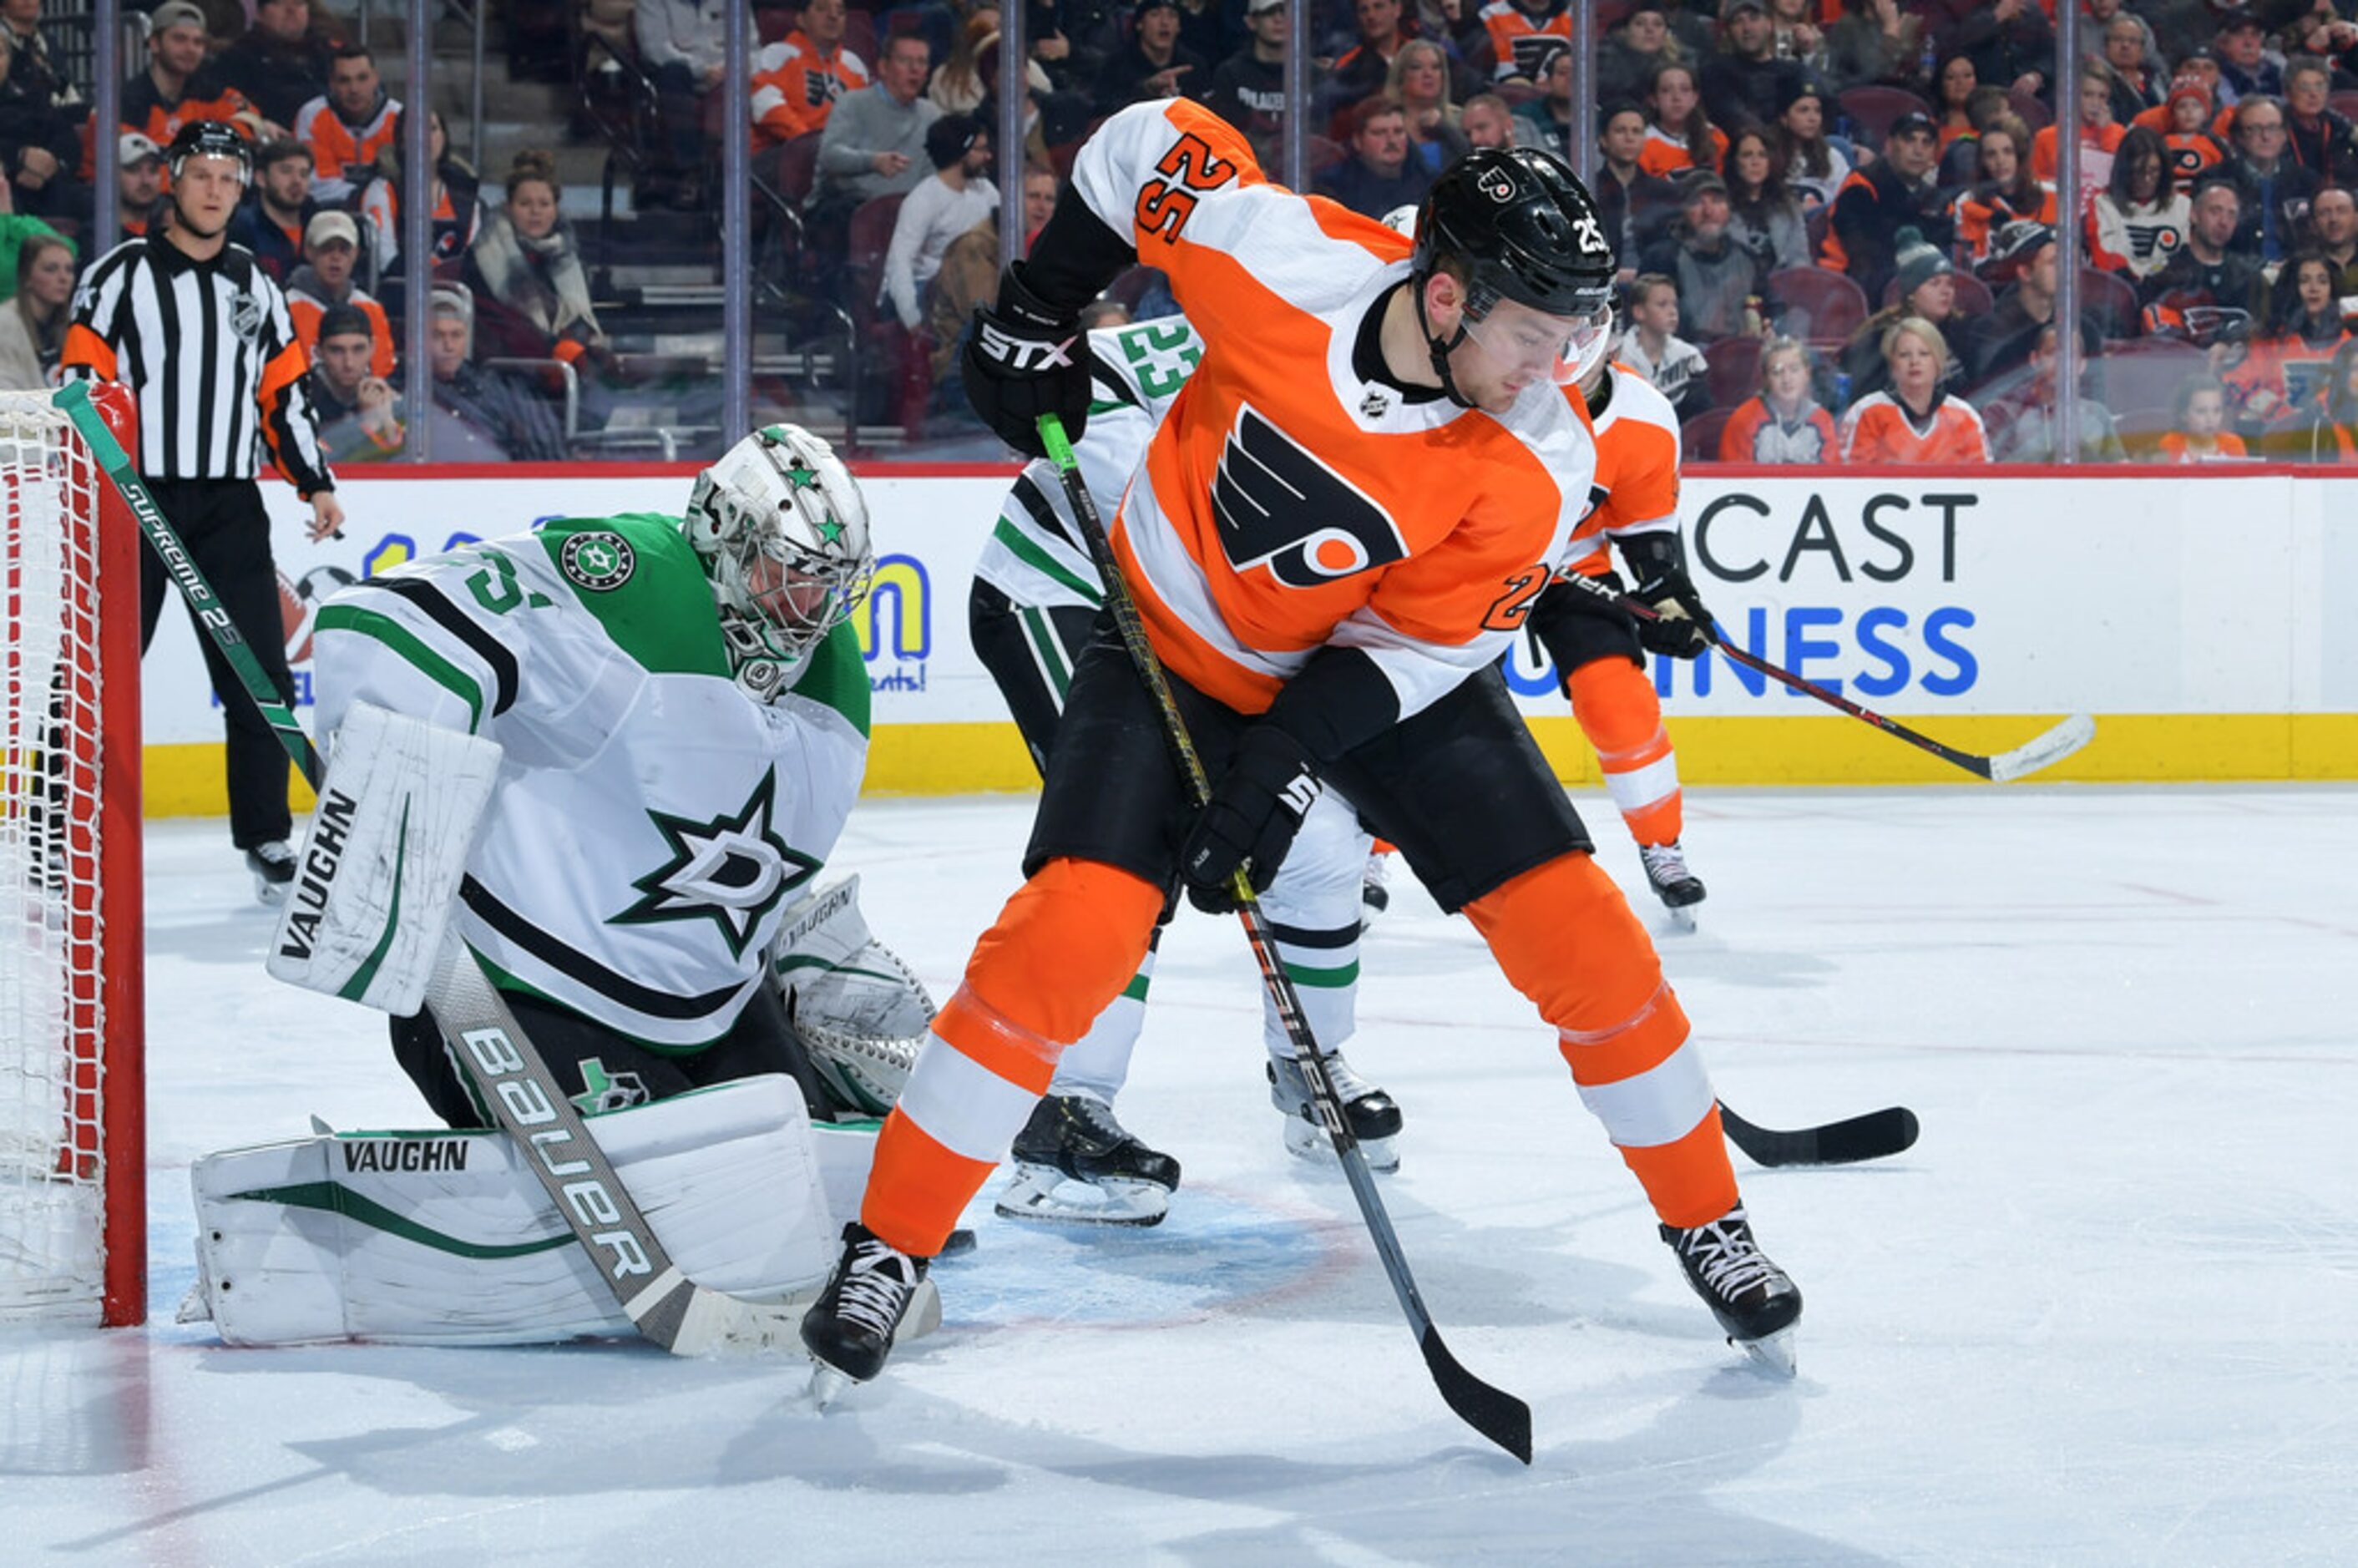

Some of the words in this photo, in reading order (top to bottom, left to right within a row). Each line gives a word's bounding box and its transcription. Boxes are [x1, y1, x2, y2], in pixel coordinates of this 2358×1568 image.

[1135, 131, 1237, 247] 25
[1572, 210, 1611, 253] 25
[979, 322, 1079, 371] STX
[1117, 324, 1202, 399] 23
[1694, 493, 1978, 583] CAST
[1480, 562, 1551, 631] 2
[1557, 566, 1621, 601] UER
[281, 787, 357, 960] VAUGHN
[343, 1140, 468, 1173] VAUGHN
[460, 1027, 653, 1281] BAUER
